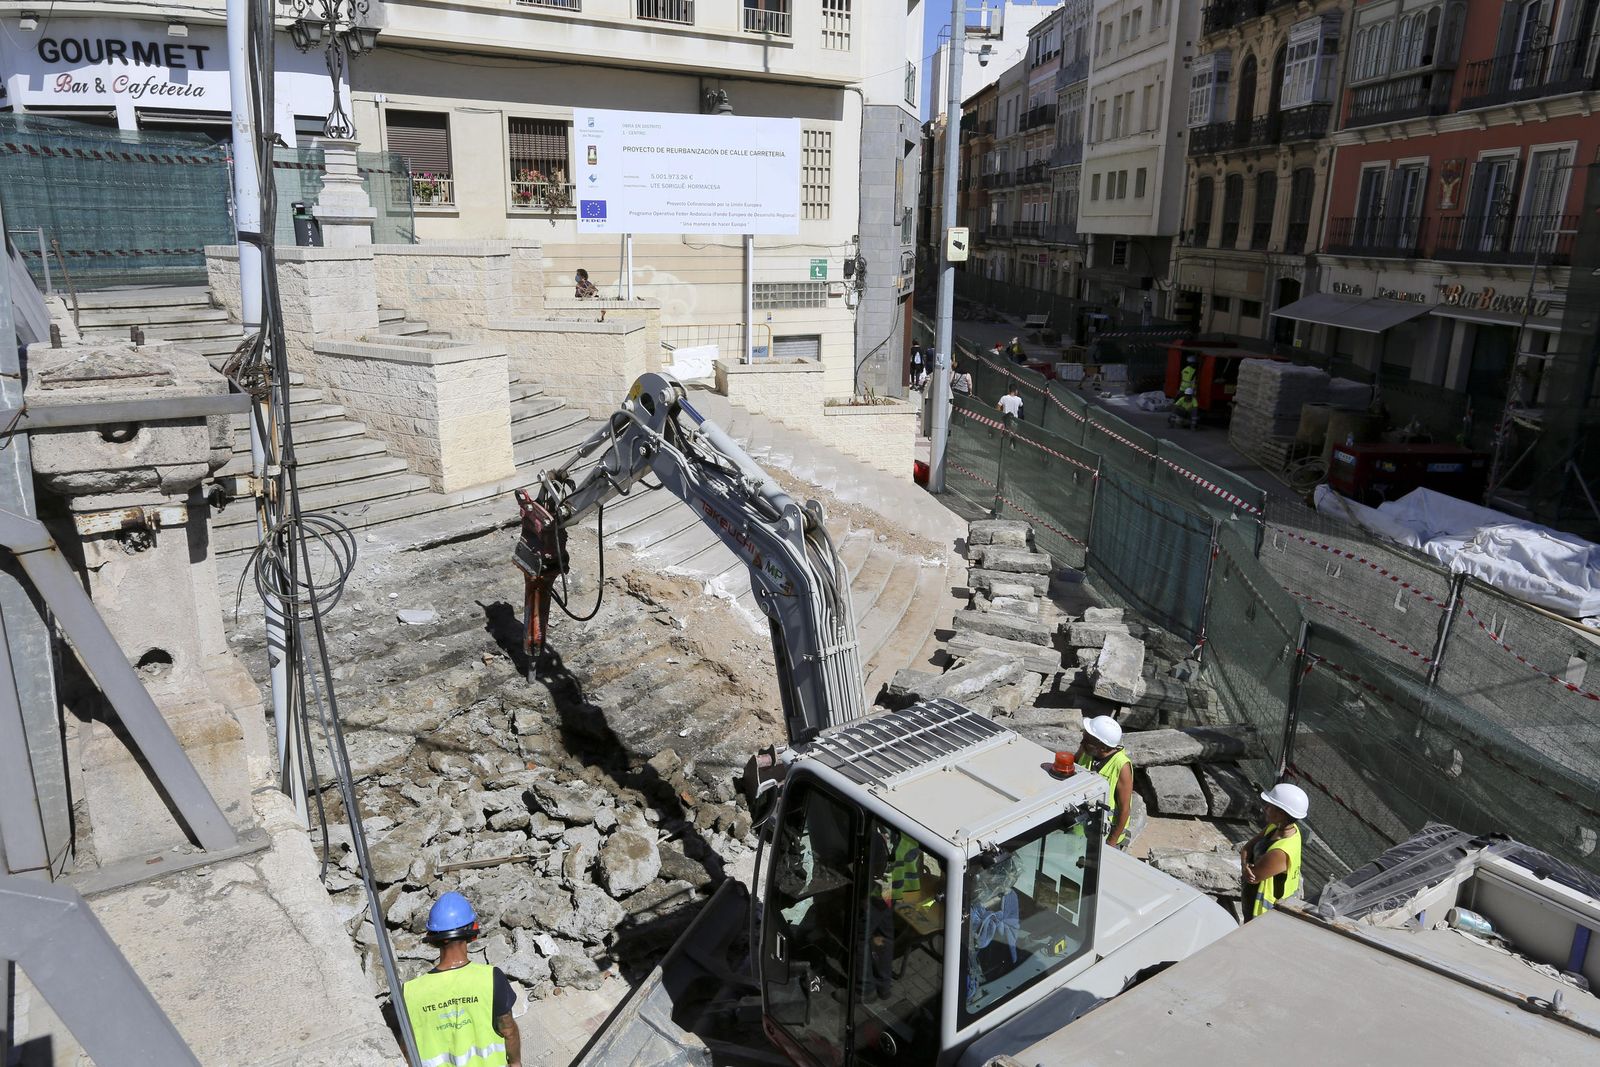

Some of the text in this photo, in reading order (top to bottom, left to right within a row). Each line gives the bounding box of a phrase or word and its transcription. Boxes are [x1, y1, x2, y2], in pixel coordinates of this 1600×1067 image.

[38, 38, 210, 69] GOURMET
[54, 73, 89, 94] Bar
[95, 77, 106, 94] &
[666, 147, 719, 155] REURBANIZACIÓN
